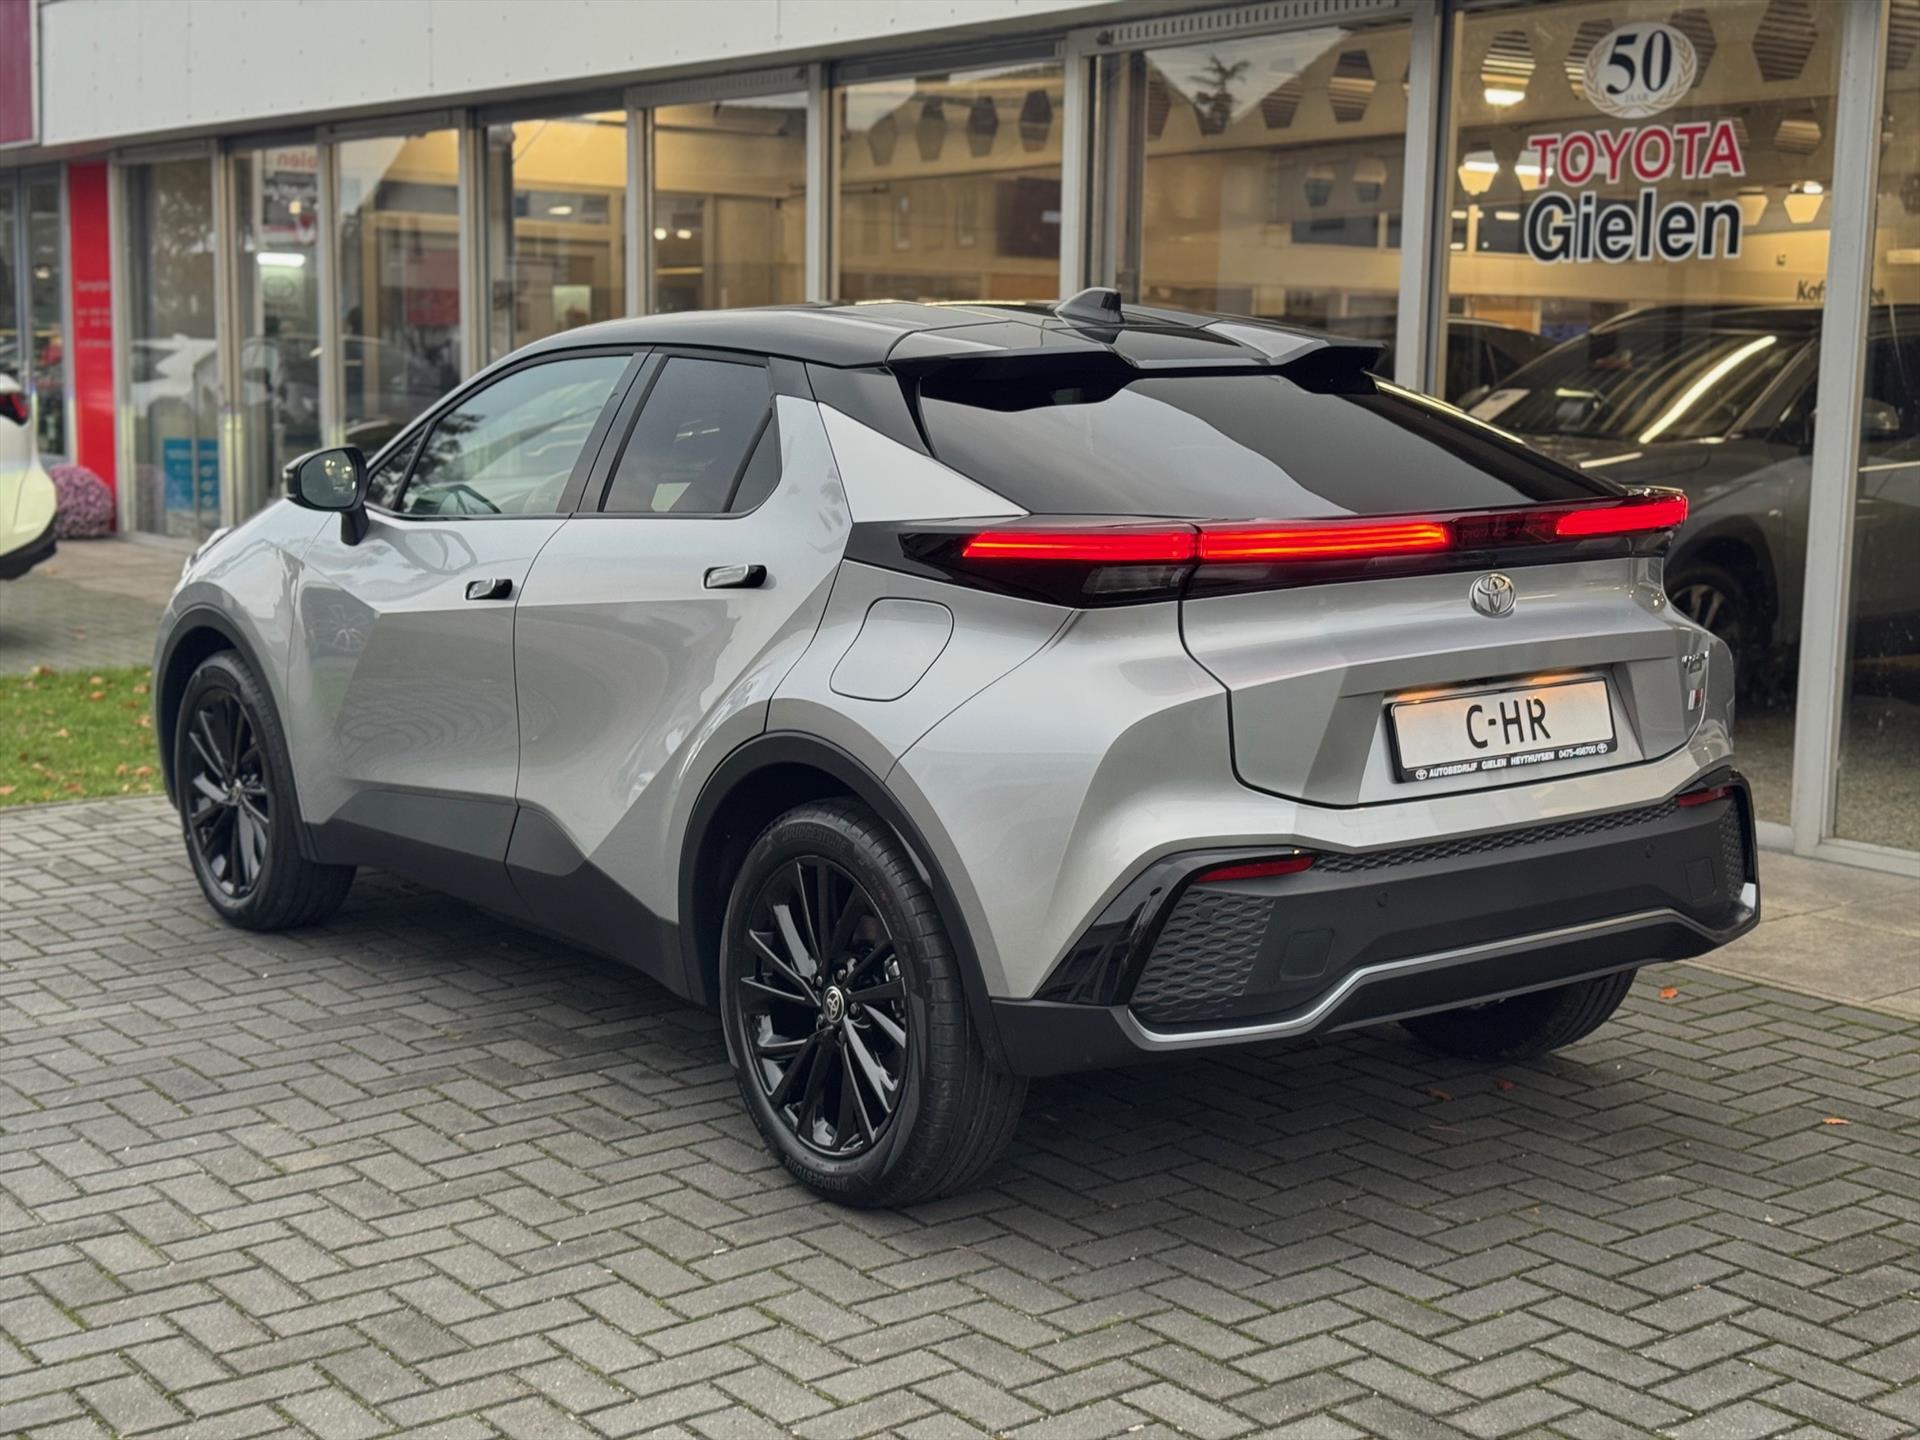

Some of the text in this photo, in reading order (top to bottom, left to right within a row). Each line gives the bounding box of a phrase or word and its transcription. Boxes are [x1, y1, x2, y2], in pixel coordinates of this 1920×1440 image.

[1605, 29, 1673, 95] 50
[1529, 121, 1745, 187] TOYOTA
[1525, 188, 1743, 263] Gielen
[1466, 698, 1551, 748] C-HR
[1429, 762, 1477, 778] AUTOBEDRIJF
[1481, 758, 1507, 770] GIELEN
[1510, 751, 1555, 766] HEYTHUYSEN
